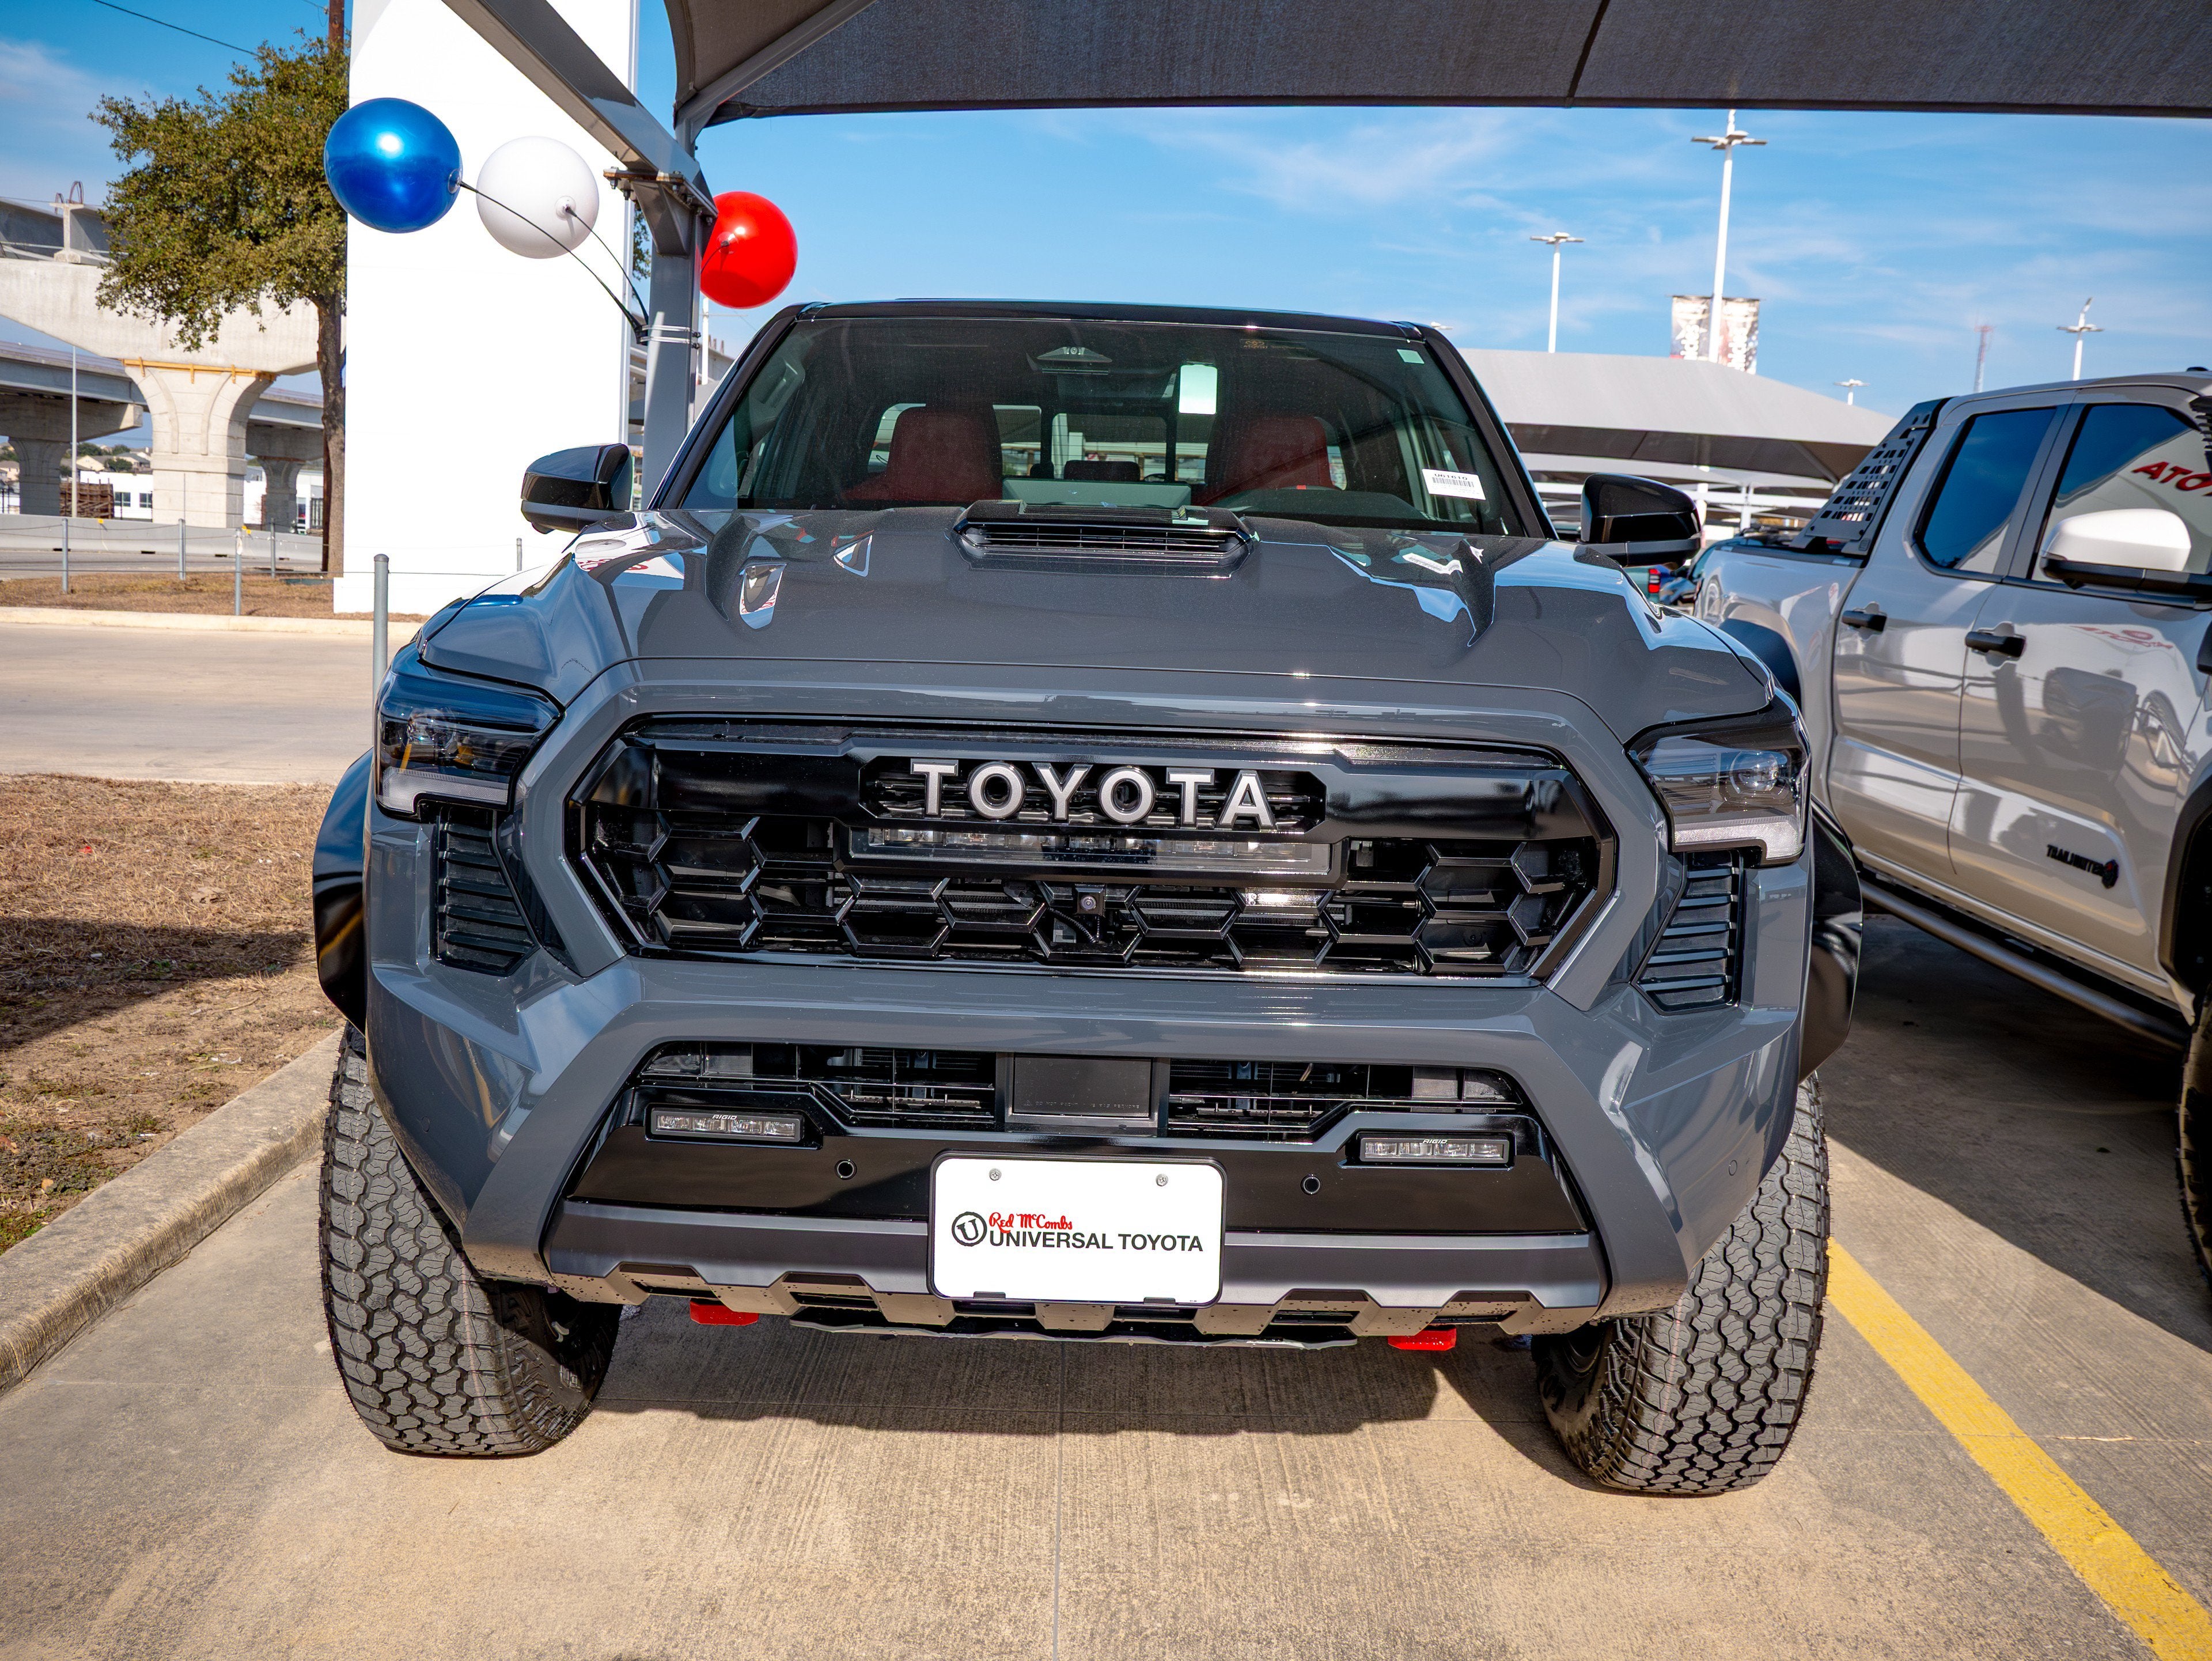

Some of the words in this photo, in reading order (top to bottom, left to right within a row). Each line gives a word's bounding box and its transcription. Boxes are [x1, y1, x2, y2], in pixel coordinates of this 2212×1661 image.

[911, 759, 1275, 830] TOYOTA
[989, 1212, 1014, 1234] Red
[1016, 1213, 1073, 1230] McCombs
[990, 1230, 1113, 1248] UNIVERSAL
[1118, 1234, 1203, 1251] TOYOTA
